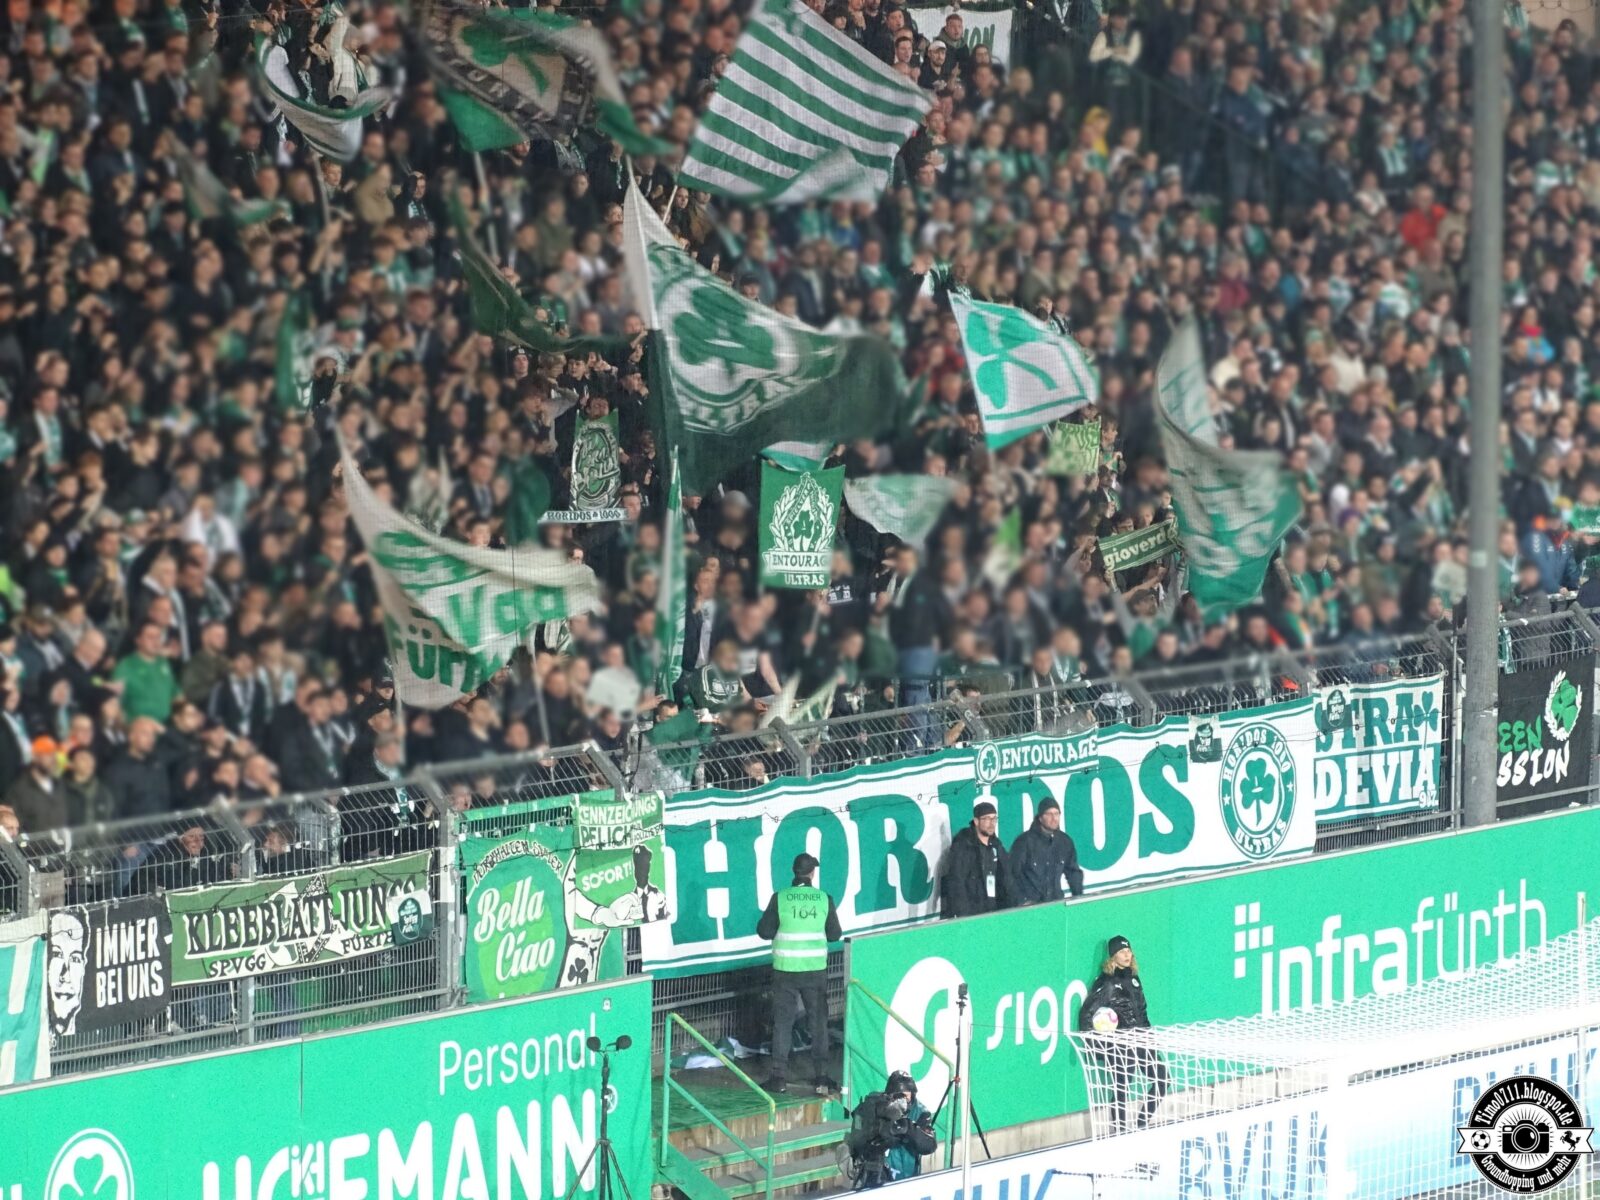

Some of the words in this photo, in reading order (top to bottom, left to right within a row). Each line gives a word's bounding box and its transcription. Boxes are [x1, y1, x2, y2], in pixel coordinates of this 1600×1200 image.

[784, 573, 825, 586] ULTRAS
[1001, 734, 1098, 770] ENTOURAGE
[1497, 715, 1542, 754] EEN
[1313, 746, 1436, 812] DEVIA
[1235, 818, 1287, 854] ULTRAS
[581, 861, 634, 892] SOFORT!
[786, 893, 821, 902] ORDNER
[183, 892, 334, 959] KLEEBLATT
[473, 875, 545, 942] Bella
[791, 905, 818, 920] 164
[96, 916, 160, 969] IMMER
[495, 930, 556, 982] Ciao
[1261, 878, 1548, 1018] infrafürth
[96, 964, 123, 1008] BEI
[127, 960, 165, 1001] UNS
[438, 1012, 597, 1096] Personal
